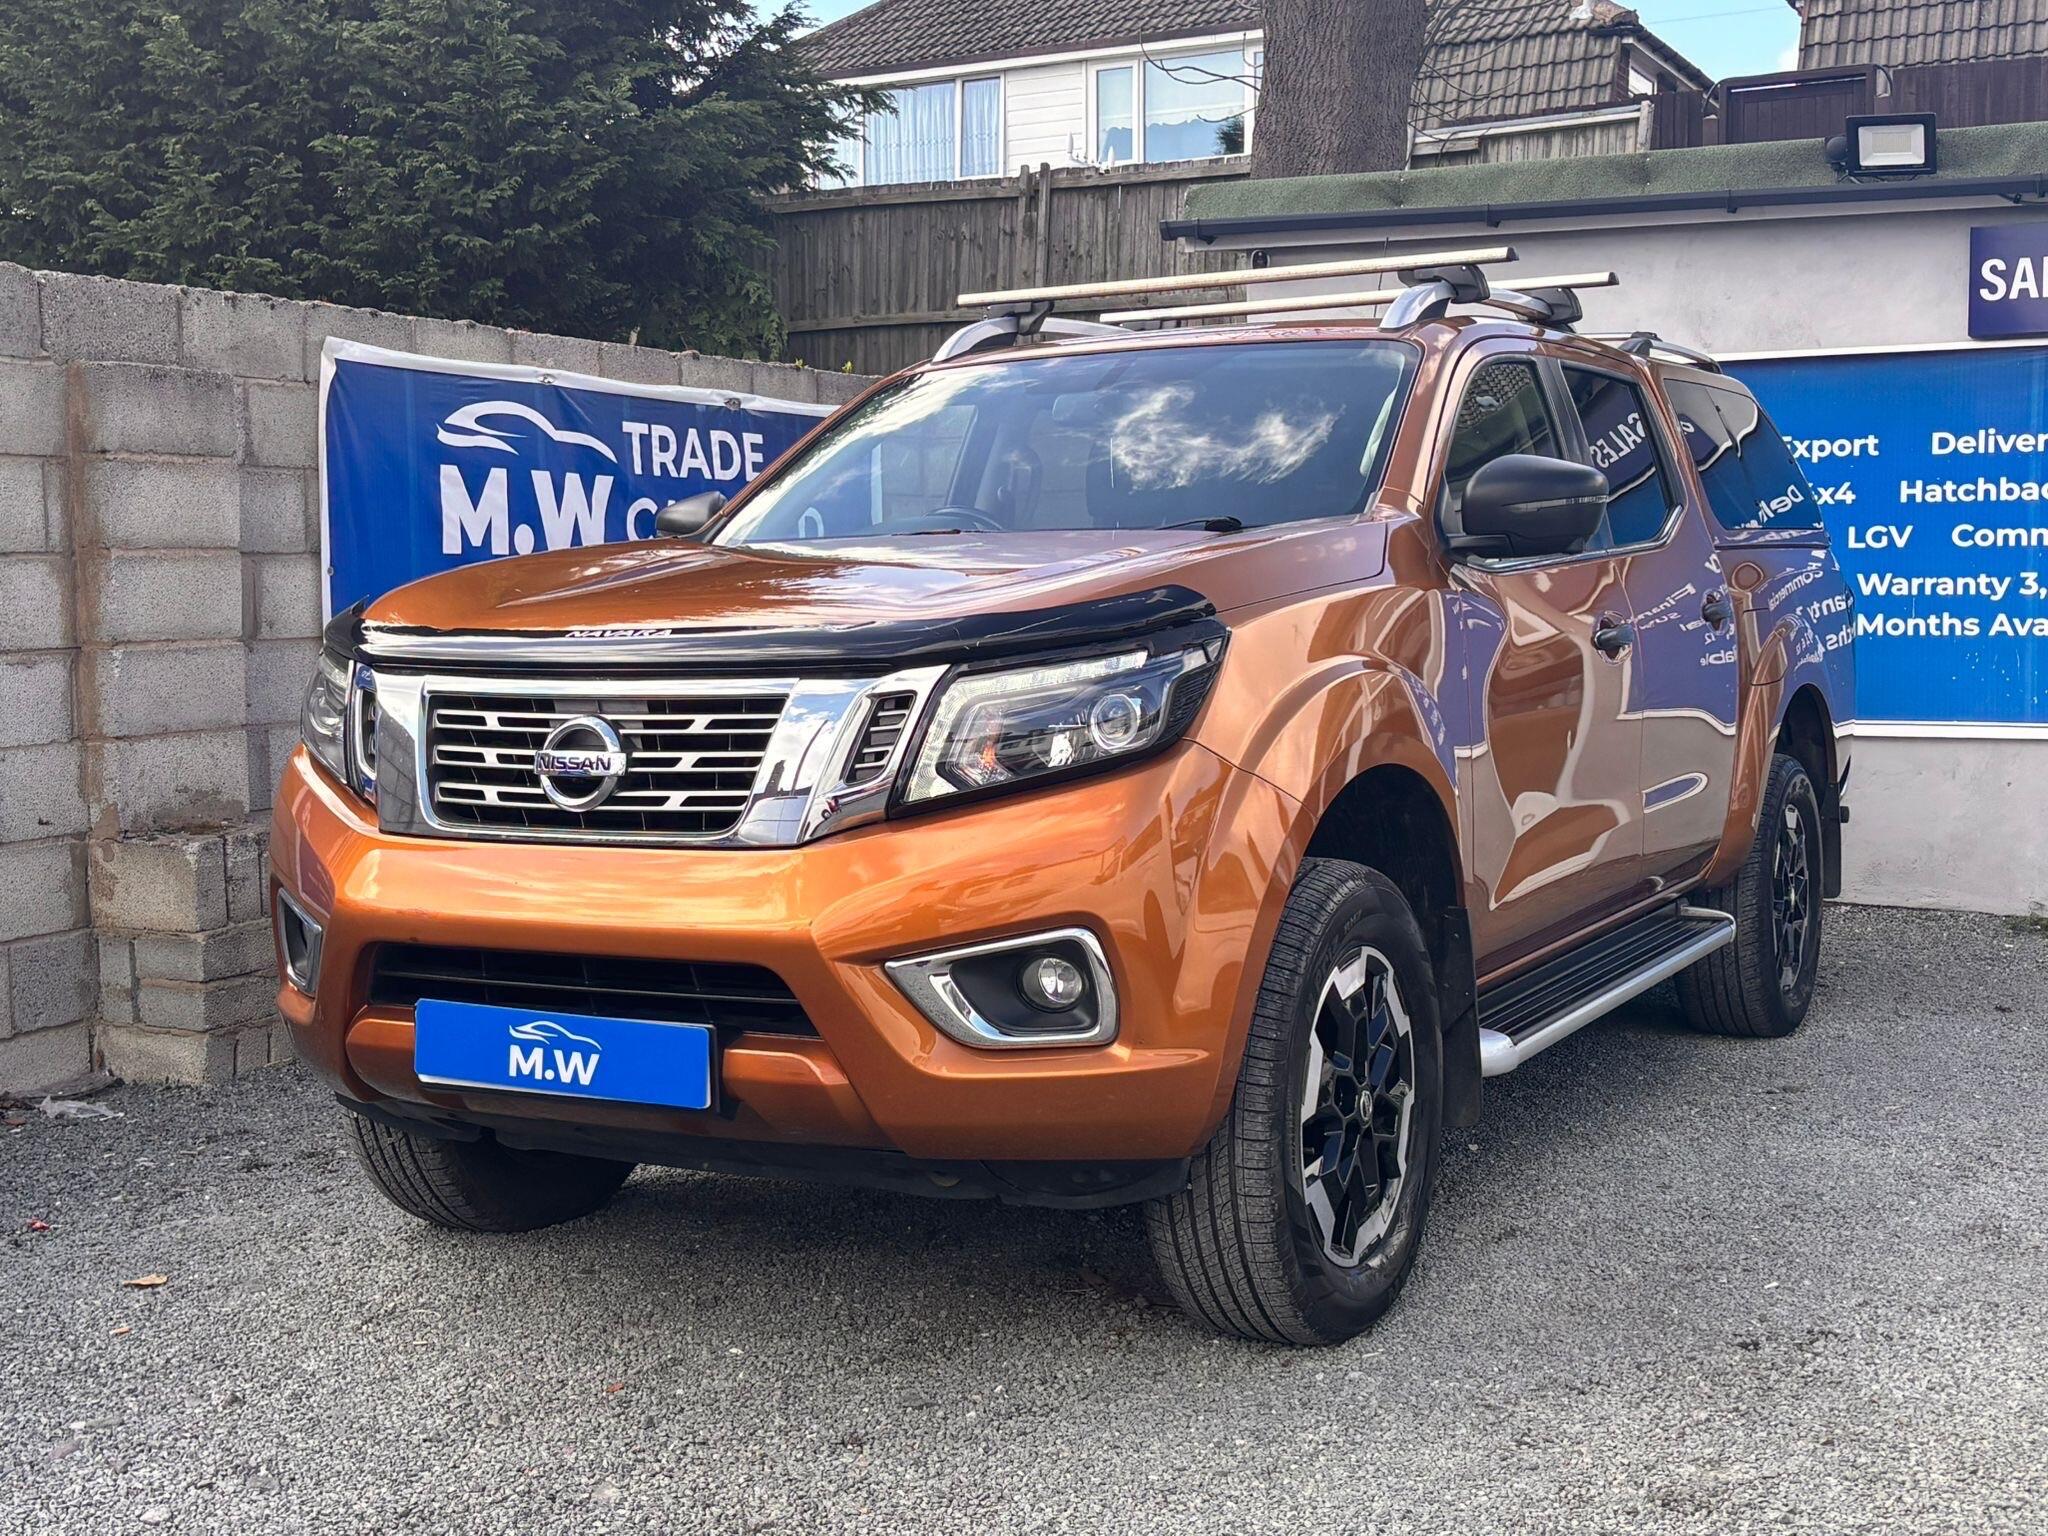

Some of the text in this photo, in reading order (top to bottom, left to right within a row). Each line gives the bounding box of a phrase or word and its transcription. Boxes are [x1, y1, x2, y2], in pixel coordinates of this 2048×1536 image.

[1979, 256, 2048, 301] SA
[622, 421, 764, 481] TRADE
[1809, 482, 1856, 505] x4
[439, 464, 614, 555] M.W
[1848, 525, 1913, 549] LGV
[1856, 572, 2011, 601] Warranty
[565, 629, 672, 638] NAVARA
[1857, 612, 1980, 637] Months
[535, 752, 612, 771] NISSAN
[508, 1044, 600, 1086] M.W
